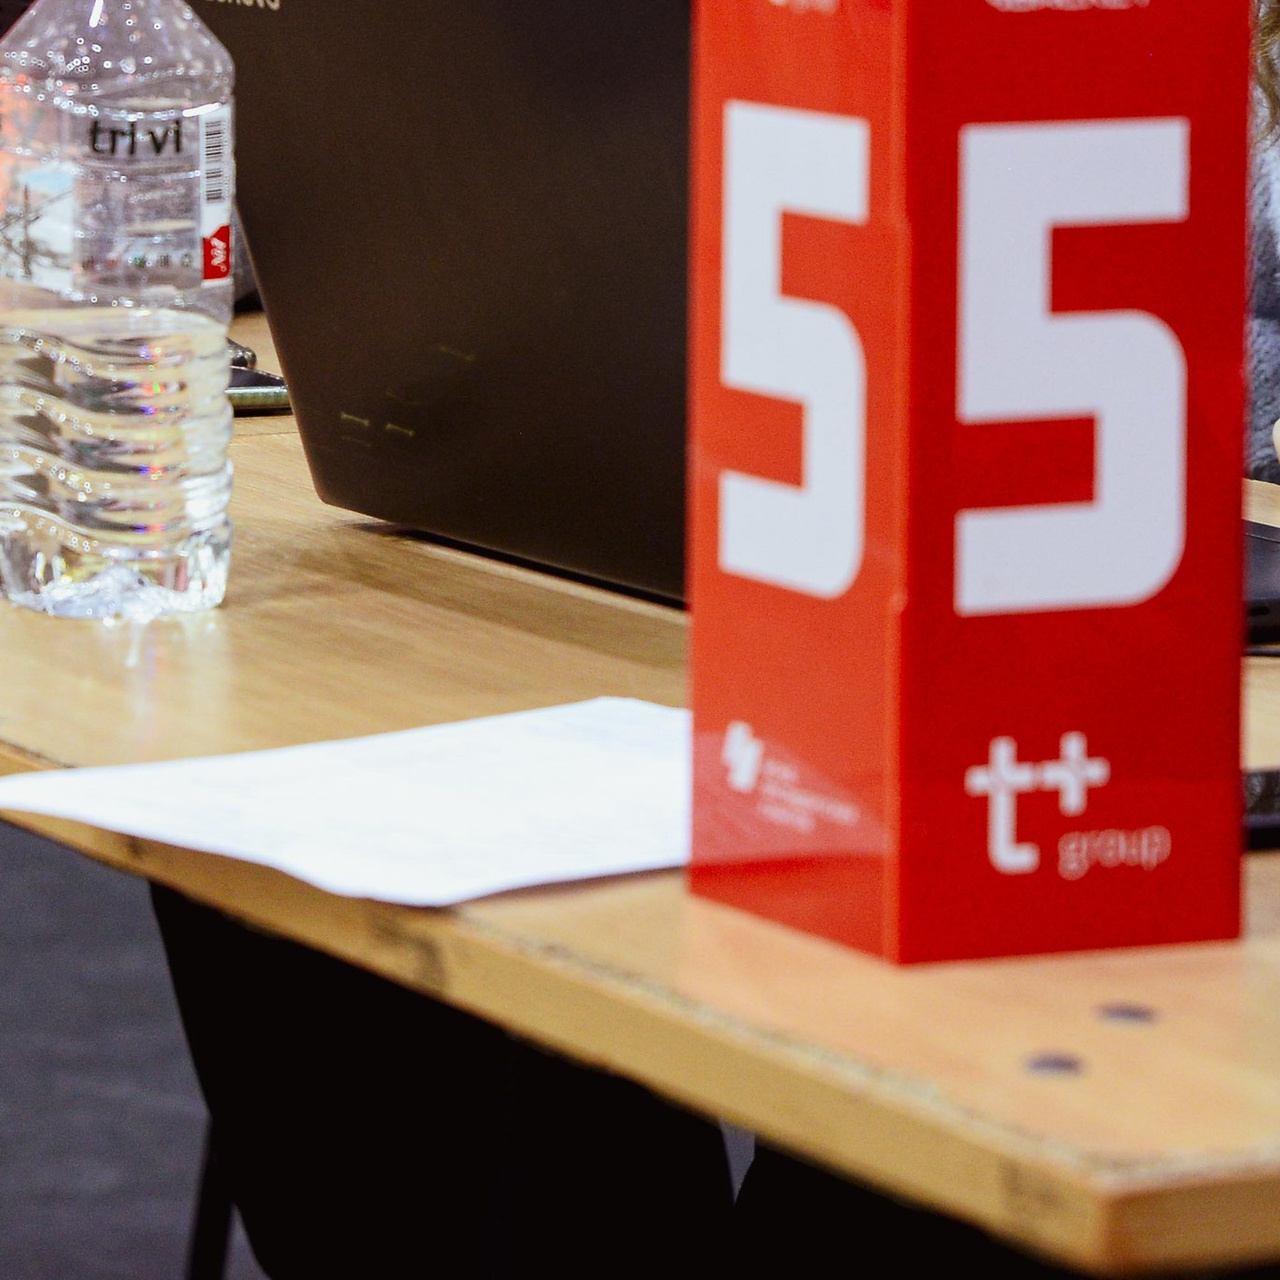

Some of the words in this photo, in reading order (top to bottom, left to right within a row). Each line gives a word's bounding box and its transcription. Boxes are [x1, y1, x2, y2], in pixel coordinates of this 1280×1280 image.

[719, 98, 872, 601] 5
[953, 115, 1191, 617] 5
[1057, 826, 1172, 881] group
